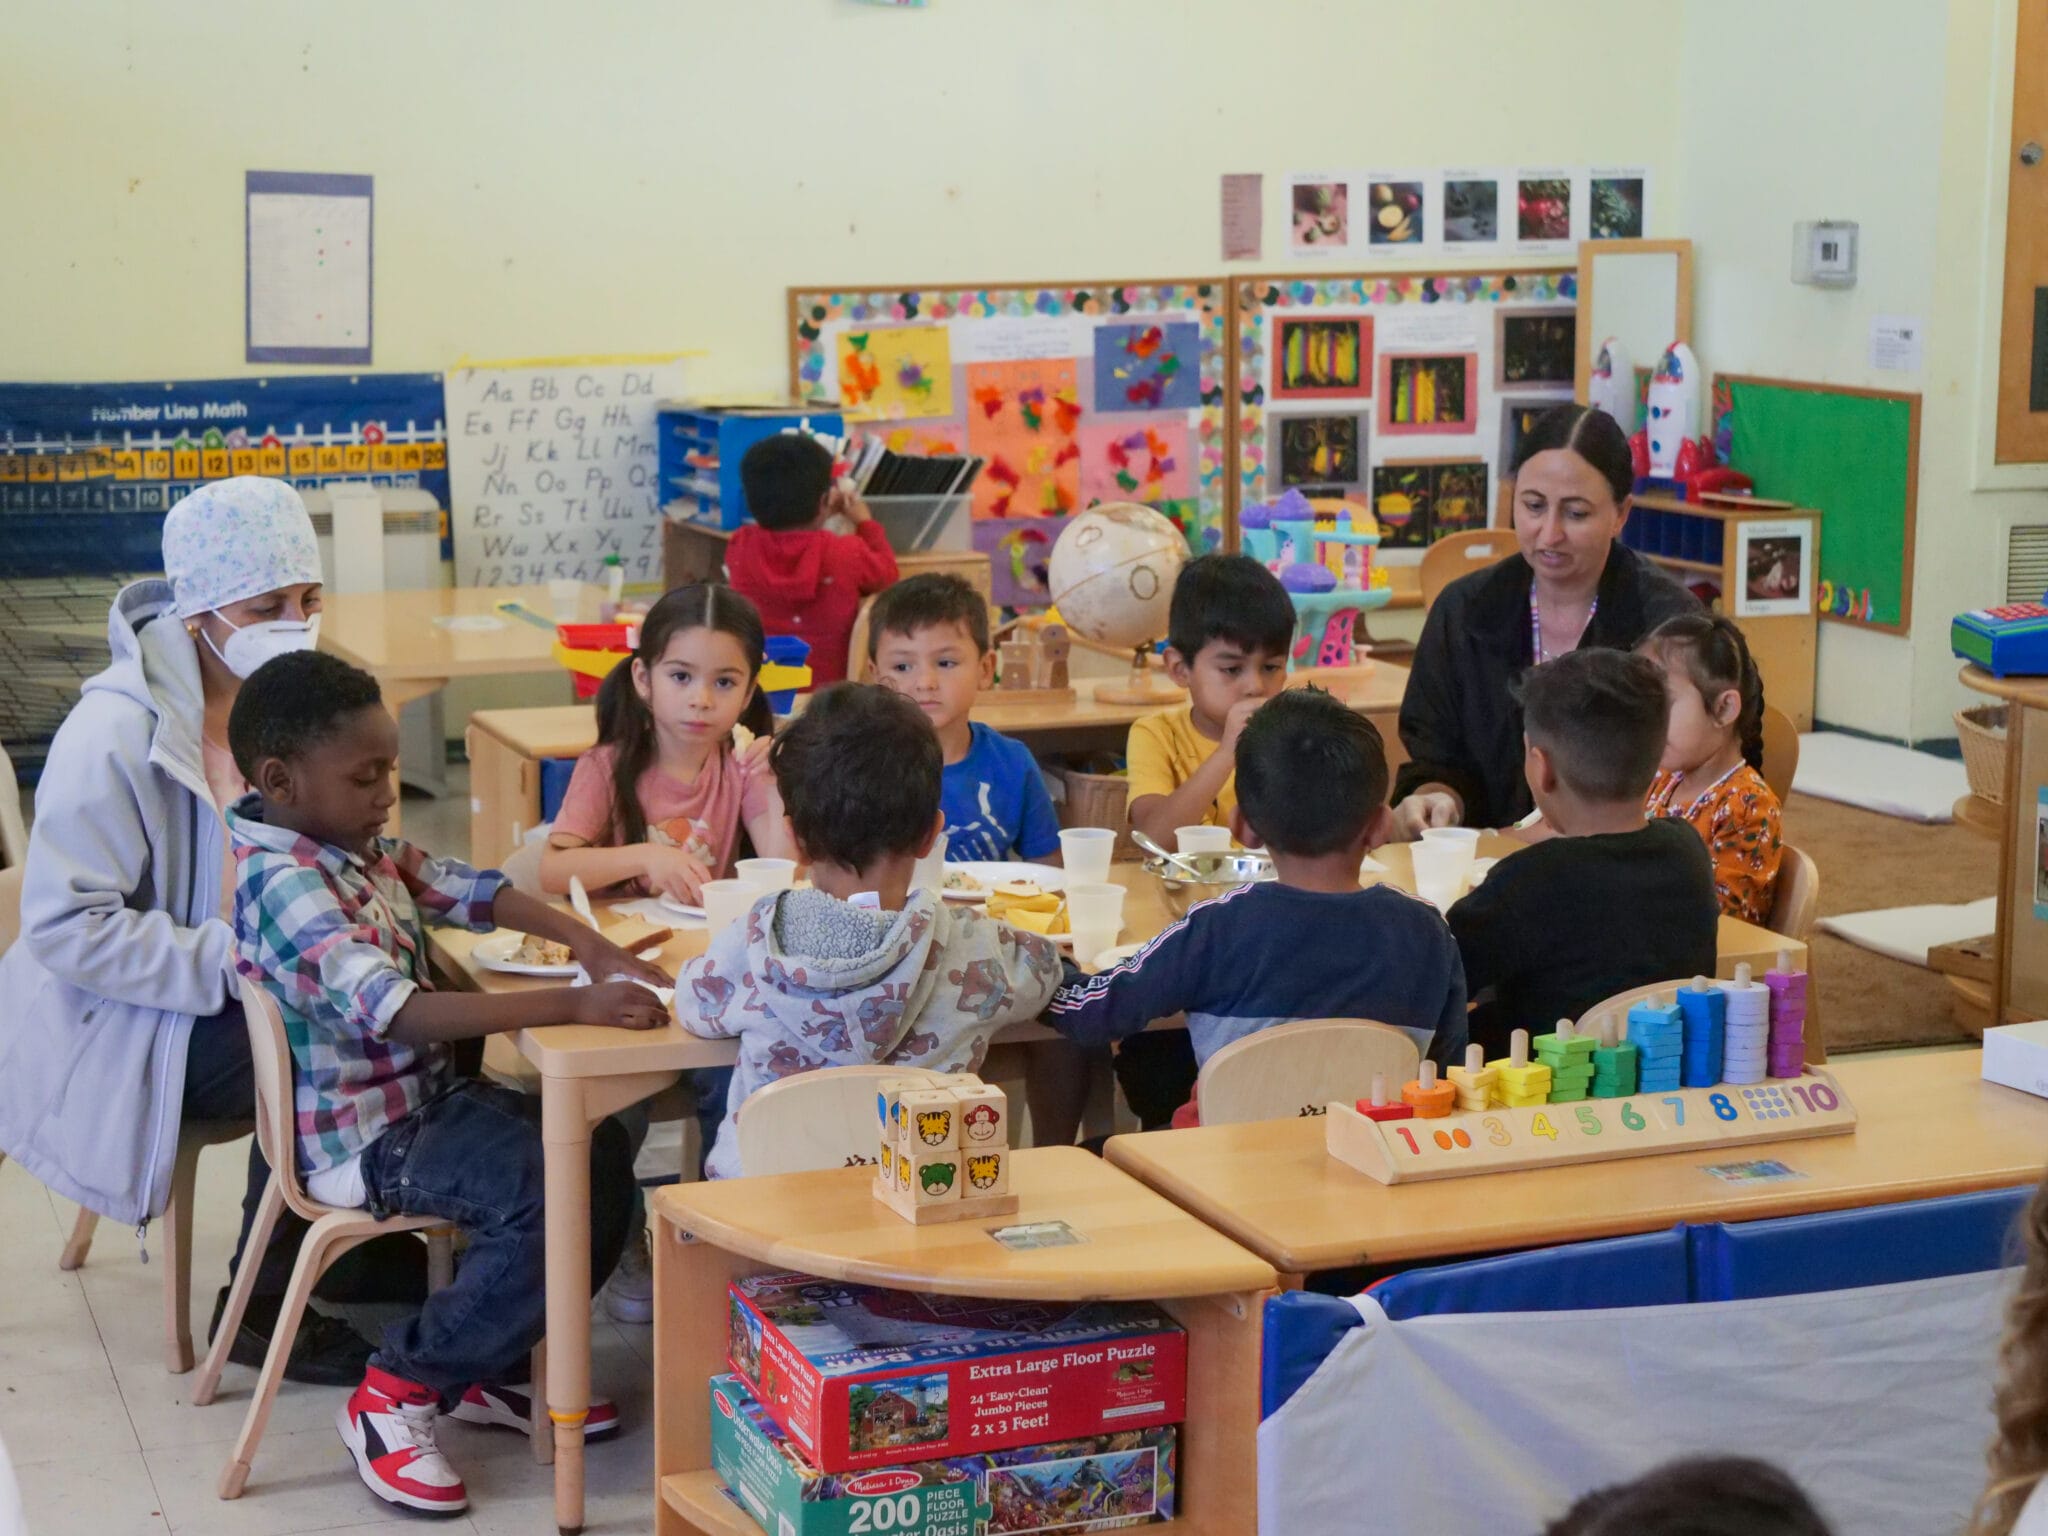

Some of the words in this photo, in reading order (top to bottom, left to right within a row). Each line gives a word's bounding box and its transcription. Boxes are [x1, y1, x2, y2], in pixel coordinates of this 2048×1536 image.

[481, 381, 513, 402] Aa
[530, 377, 559, 401] Bb
[575, 375, 604, 398] Cc
[621, 373, 654, 396] Dd
[92, 404, 161, 421] Number
[164, 403, 199, 420] Line
[203, 400, 248, 418] Math
[464, 411, 492, 436] Ee
[508, 408, 539, 432] Ff
[555, 406, 586, 439] Gg
[602, 405, 632, 427] Hh
[526, 440, 559, 463] Kk
[614, 434, 657, 457] Mm
[150, 457, 167, 472] 10
[179, 457, 194, 472] 11
[208, 456, 224, 472] 12
[238, 456, 253, 471] 13
[265, 454, 281, 469] 14
[295, 453, 310, 467] 15
[322, 453, 338, 467] 16
[350, 451, 365, 466] 17
[377, 451, 393, 466] 18
[404, 449, 419, 465] 19
[424, 449, 445, 464] 20
[484, 473, 518, 496] Nn
[535, 469, 567, 493] Oo
[585, 467, 613, 498] Pp
[142, 489, 159, 502] 10
[473, 505, 504, 529] Rr
[518, 502, 545, 526] Ss
[563, 499, 588, 523] Tt
[602, 497, 633, 520] Uu
[483, 535, 528, 559] Ww
[542, 531, 578, 555] Xx
[595, 528, 622, 554] Yy
[1396, 1126, 1420, 1155] 1
[1482, 1116, 1513, 1147] 3
[1531, 1113, 1558, 1141] 4
[1574, 1106, 1602, 1135] 5
[1621, 1102, 1646, 1131] 6
[1662, 1097, 1686, 1126] 7
[1709, 1093, 1738, 1121] 8
[1791, 1083, 1838, 1113] 10
[969, 1364, 1012, 1380] Extra
[1016, 1357, 1060, 1374] Large
[1063, 1351, 1102, 1368] Floor
[1107, 1343, 1156, 1362] Puzzle
[969, 1394, 984, 1404] 24
[974, 1404, 1012, 1418] Jumbo
[1015, 1399, 1048, 1411] Pieces
[970, 1424, 981, 1437] 2
[984, 1423, 994, 1434] x
[998, 1420, 1008, 1434] 3
[1012, 1413, 1049, 1431] Feet!
[853, 1480, 887, 1493] Melissa
[889, 1478, 893, 1486] &
[895, 1476, 916, 1489] Doug
[927, 1488, 961, 1500] PIECE
[848, 1494, 921, 1534] 200
[926, 1498, 965, 1513] FLOOR
[926, 1508, 969, 1523] PUZZLE
[924, 1520, 969, 1536] Oasis
